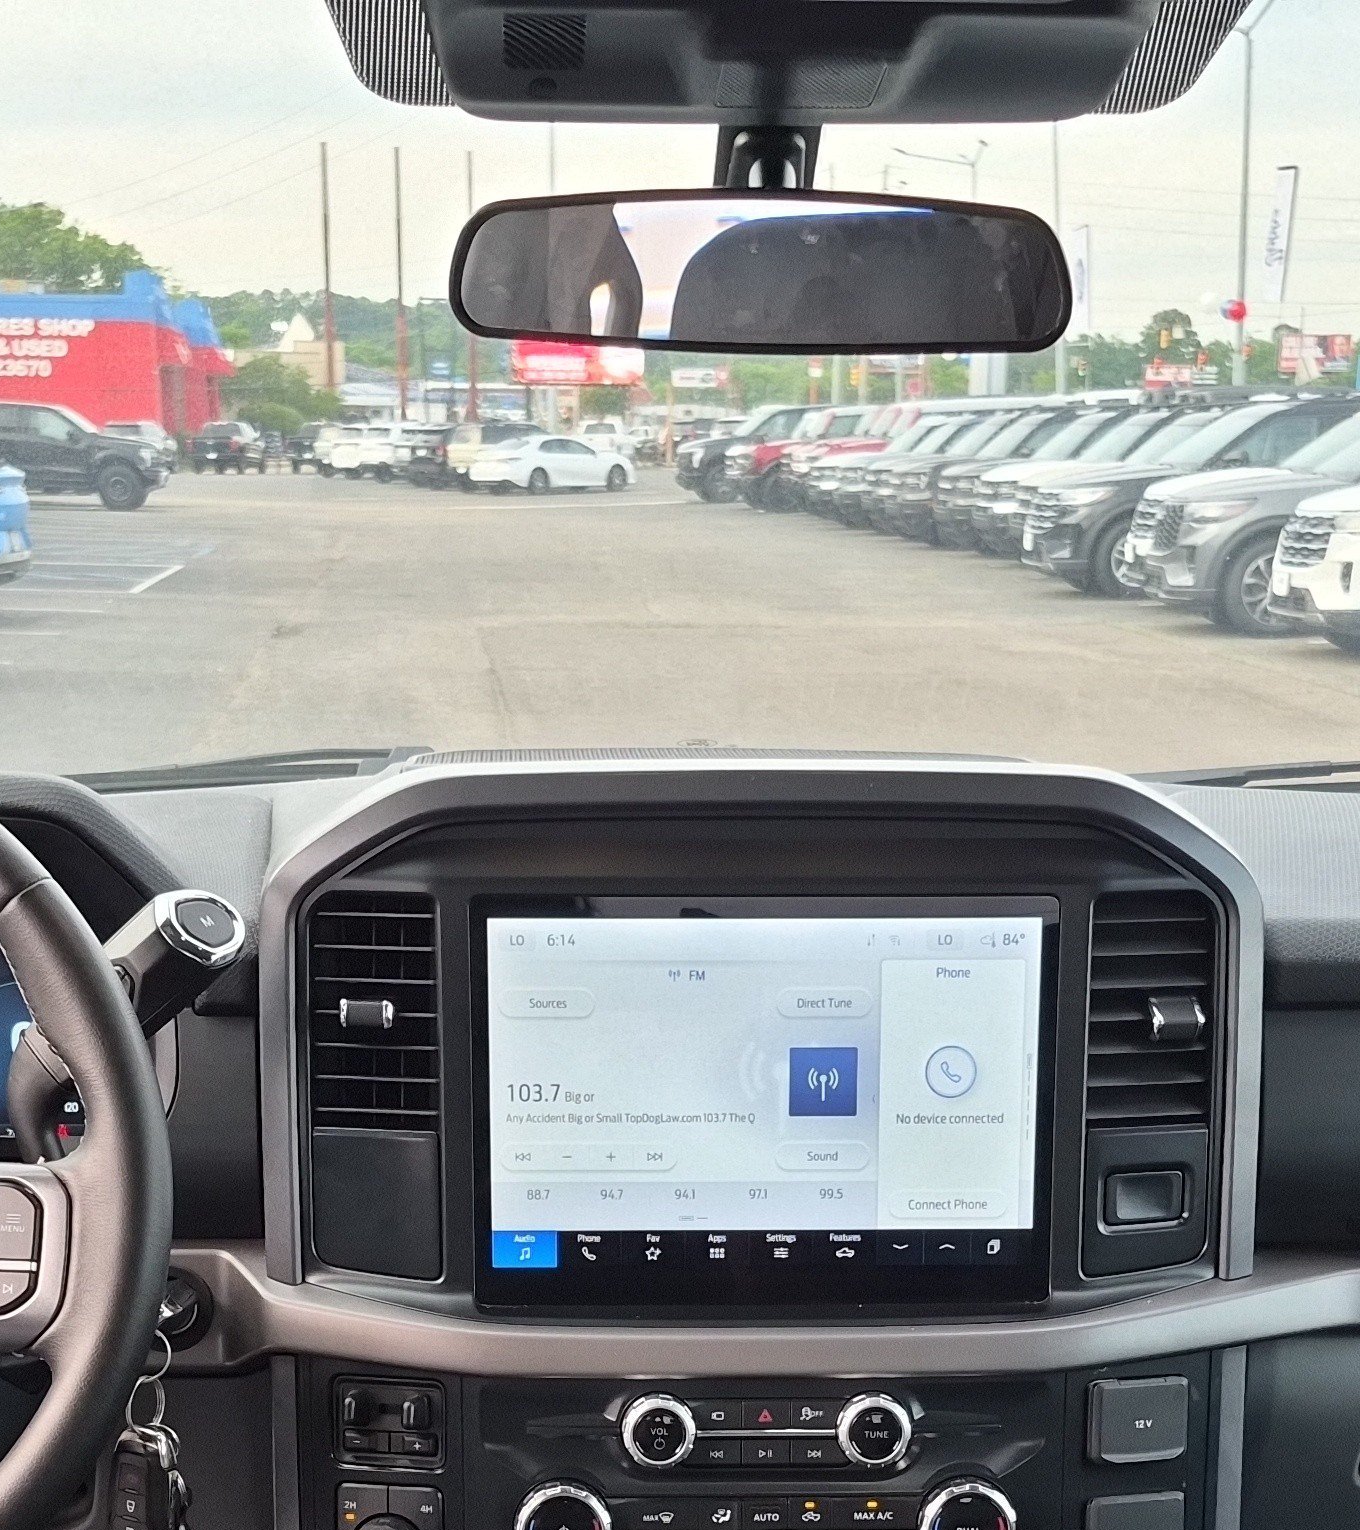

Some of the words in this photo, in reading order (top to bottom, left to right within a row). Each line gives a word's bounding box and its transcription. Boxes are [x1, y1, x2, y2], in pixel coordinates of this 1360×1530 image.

[37, 318, 95, 336] SHOP
[11, 338, 68, 356] USED
[509, 935, 525, 946] LO
[547, 934, 575, 946] 6:14
[938, 934, 953, 946] LO
[1002, 933, 1026, 946] 84°
[689, 970, 706, 981] FM
[936, 967, 971, 978] Phone
[529, 998, 567, 1008] Sources
[797, 997, 825, 1008] Direct
[828, 997, 852, 1008] Tune
[506, 1083, 561, 1102] 103.7
[564, 1091, 582, 1104] Big
[583, 1093, 595, 1102] or
[506, 1113, 524, 1124] Any
[526, 1113, 566, 1123] Accident
[568, 1113, 583, 1124] Big
[584, 1115, 594, 1123] or
[596, 1113, 622, 1123] Small
[625, 1113, 701, 1124] TopDogLaw.com
[703, 1113, 727, 1123] 103.7
[729, 1113, 746, 1122] The
[747, 1113, 756, 1124] Q
[896, 1113, 911, 1124] No
[913, 1113, 947, 1124] device
[949, 1113, 1004, 1124] connected
[807, 1151, 838, 1162] Sound
[527, 1189, 550, 1200] 88.7
[600, 1189, 623, 1200] 94.7
[674, 1189, 696, 1200] 94.1
[749, 1188, 768, 1199] 97.1
[819, 1188, 843, 1199] 99.5
[908, 1199, 951, 1210] Connect
[954, 1199, 988, 1210] Phone
[0, 1225, 25, 1233] MENU
[513, 1234, 536, 1243] Audio
[577, 1234, 601, 1243] Phone
[646, 1234, 661, 1243] Fav
[707, 1234, 727, 1243] Apps
[766, 1233, 797, 1244] Settings
[829, 1233, 861, 1242] Features
[1133, 1420, 1145, 1428] 12
[1145, 1419, 1153, 1428] V
[650, 1427, 669, 1436] VOL
[864, 1430, 889, 1439] TUNE
[343, 1501, 357, 1510] 2H
[420, 1505, 433, 1514] 4H
[753, 1513, 779, 1522] AUTO
[853, 1512, 875, 1521] MAX
[877, 1511, 894, 1521] A/C
